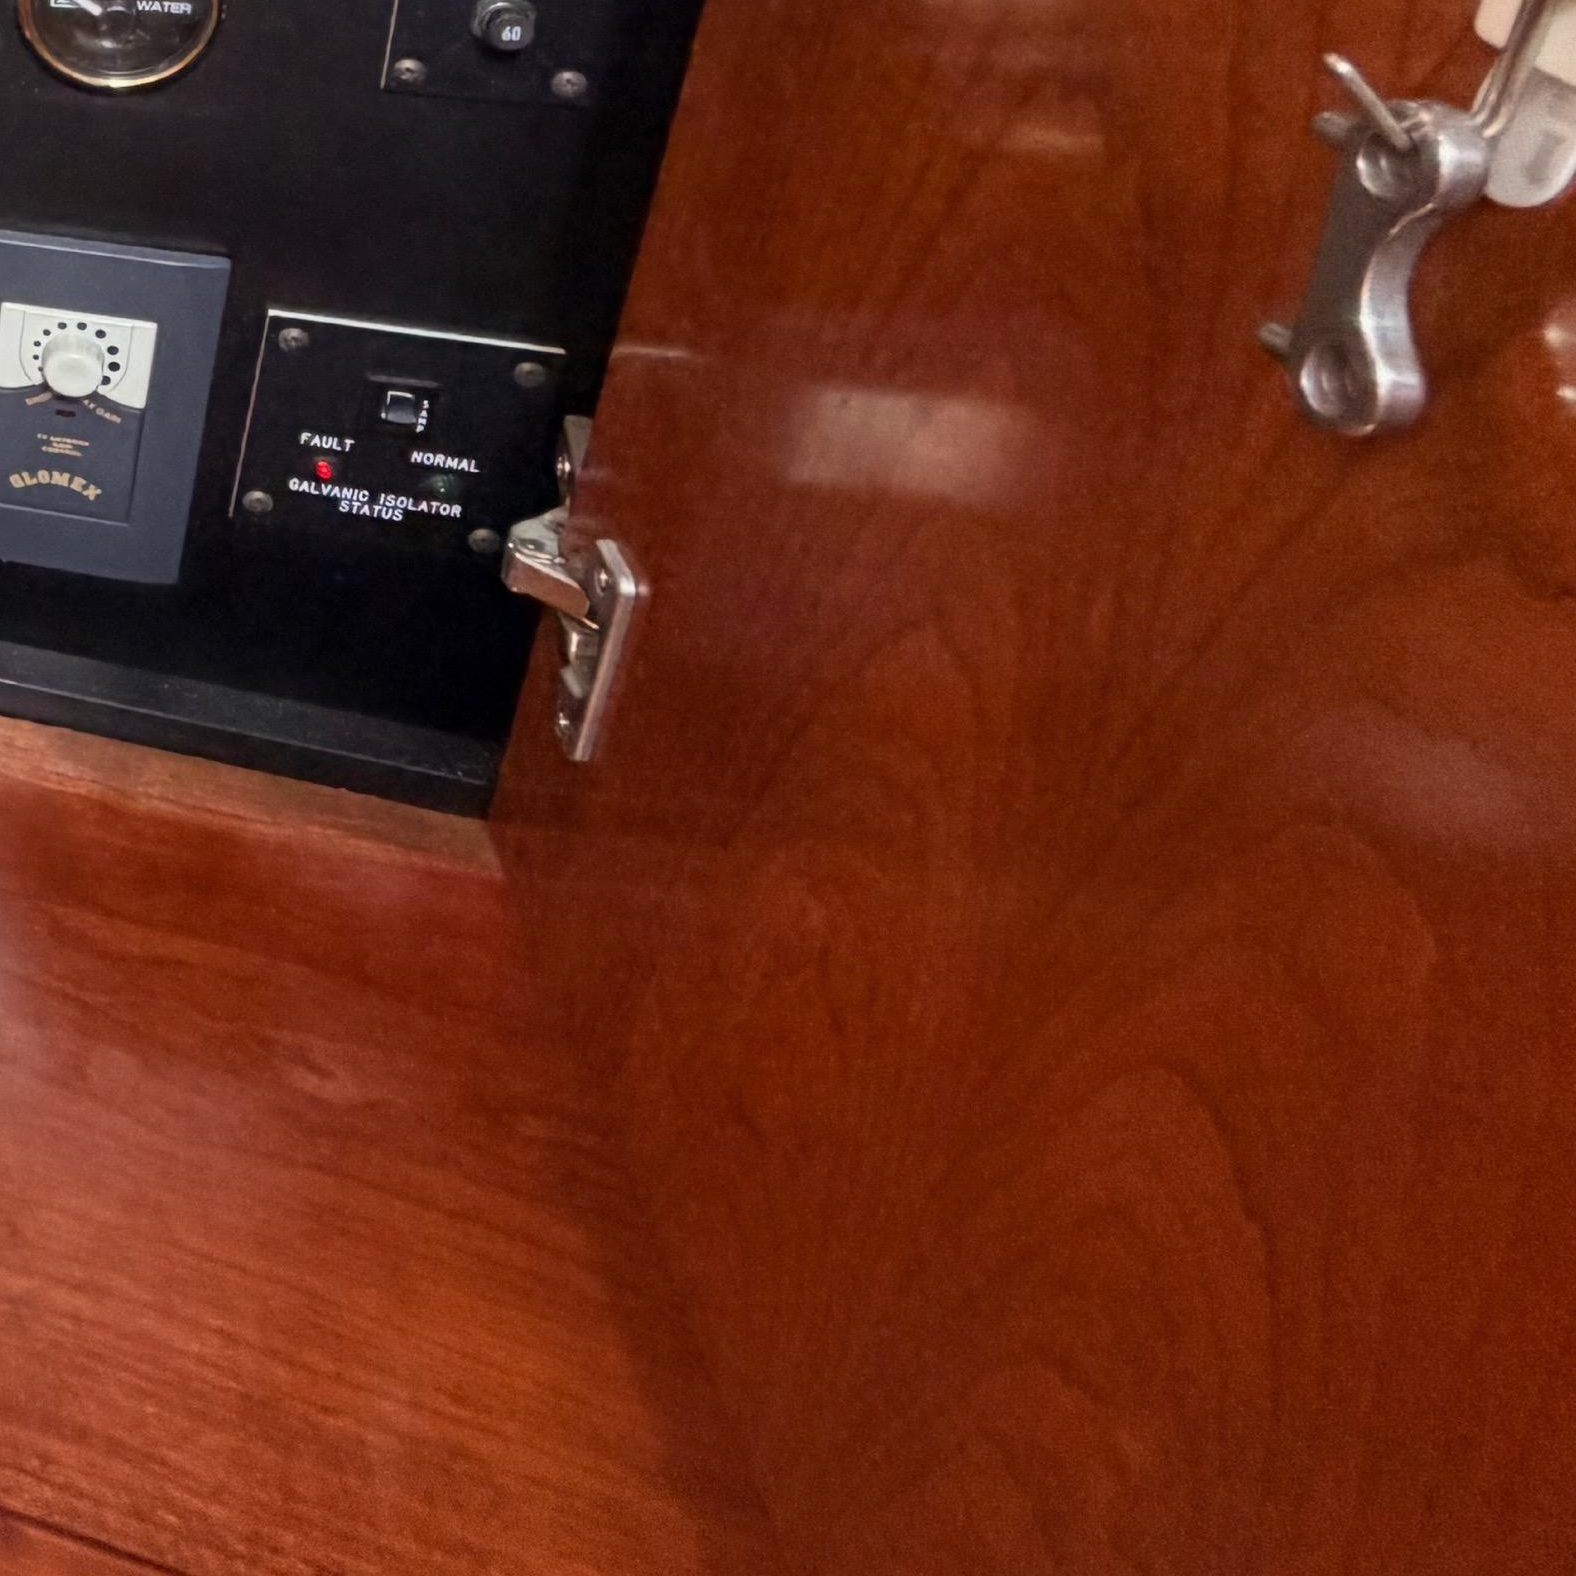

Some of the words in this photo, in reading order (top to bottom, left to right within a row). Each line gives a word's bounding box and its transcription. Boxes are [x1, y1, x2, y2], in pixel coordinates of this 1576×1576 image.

[136, 0, 192, 14] WATER
[501, 25, 521, 41] 60
[300, 432, 355, 452] FAULT
[410, 450, 479, 473] NORMAL
[9, 470, 103, 502] GLOMEX
[288, 478, 371, 502] GALVANIC
[380, 493, 463, 518] ISOLATOR
[338, 499, 403, 521] STATUS
